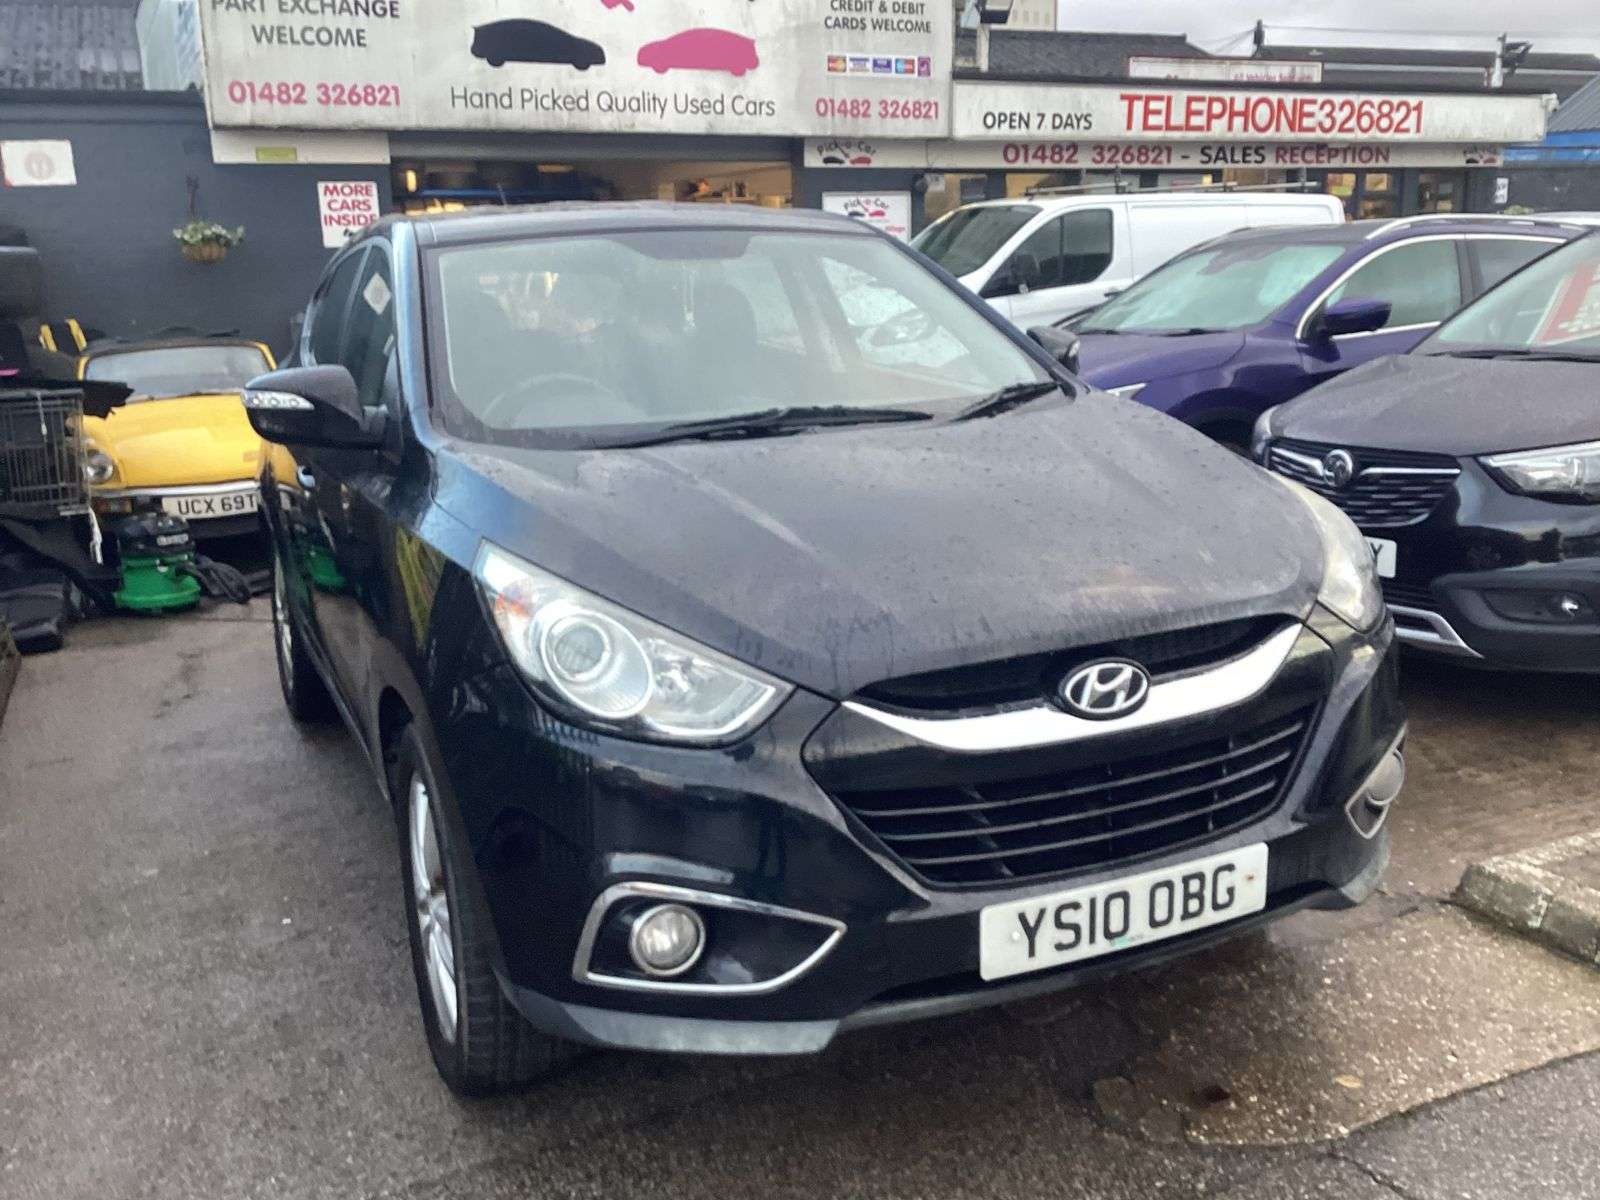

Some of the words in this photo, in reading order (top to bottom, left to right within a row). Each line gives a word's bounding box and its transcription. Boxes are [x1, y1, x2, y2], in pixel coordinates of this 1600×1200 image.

[278, 0, 400, 19] EXCHANGE
[829, 0, 872, 13] CREDIT
[877, 1, 889, 13] &
[892, 2, 926, 15] DEBIT
[251, 25, 367, 47] WELCOME
[824, 17, 867, 31] CARDS
[871, 18, 932, 34] WELCOME
[228, 80, 307, 105] 01482
[316, 82, 400, 107] 326821
[450, 86, 513, 111] Hand
[520, 88, 590, 112] Picked
[596, 91, 668, 119] Quality
[674, 94, 725, 116] Used
[731, 95, 776, 117] Cars
[815, 98, 871, 118] 01482
[878, 99, 939, 120] 326821
[983, 111, 1031, 131] OPEN
[1036, 112, 1046, 130] 7
[1051, 113, 1093, 131] DAYS
[1002, 143, 1080, 165] 01482
[1091, 145, 1173, 165] 326821
[1200, 145, 1267, 165] SALES
[1275, 146, 1391, 165] RECEPTION
[323, 184, 374, 197] MORE
[327, 199, 372, 211] CARS
[178, 499, 215, 516] UCX
[220, 493, 256, 512] 69T
[1018, 890, 1130, 960] YS10
